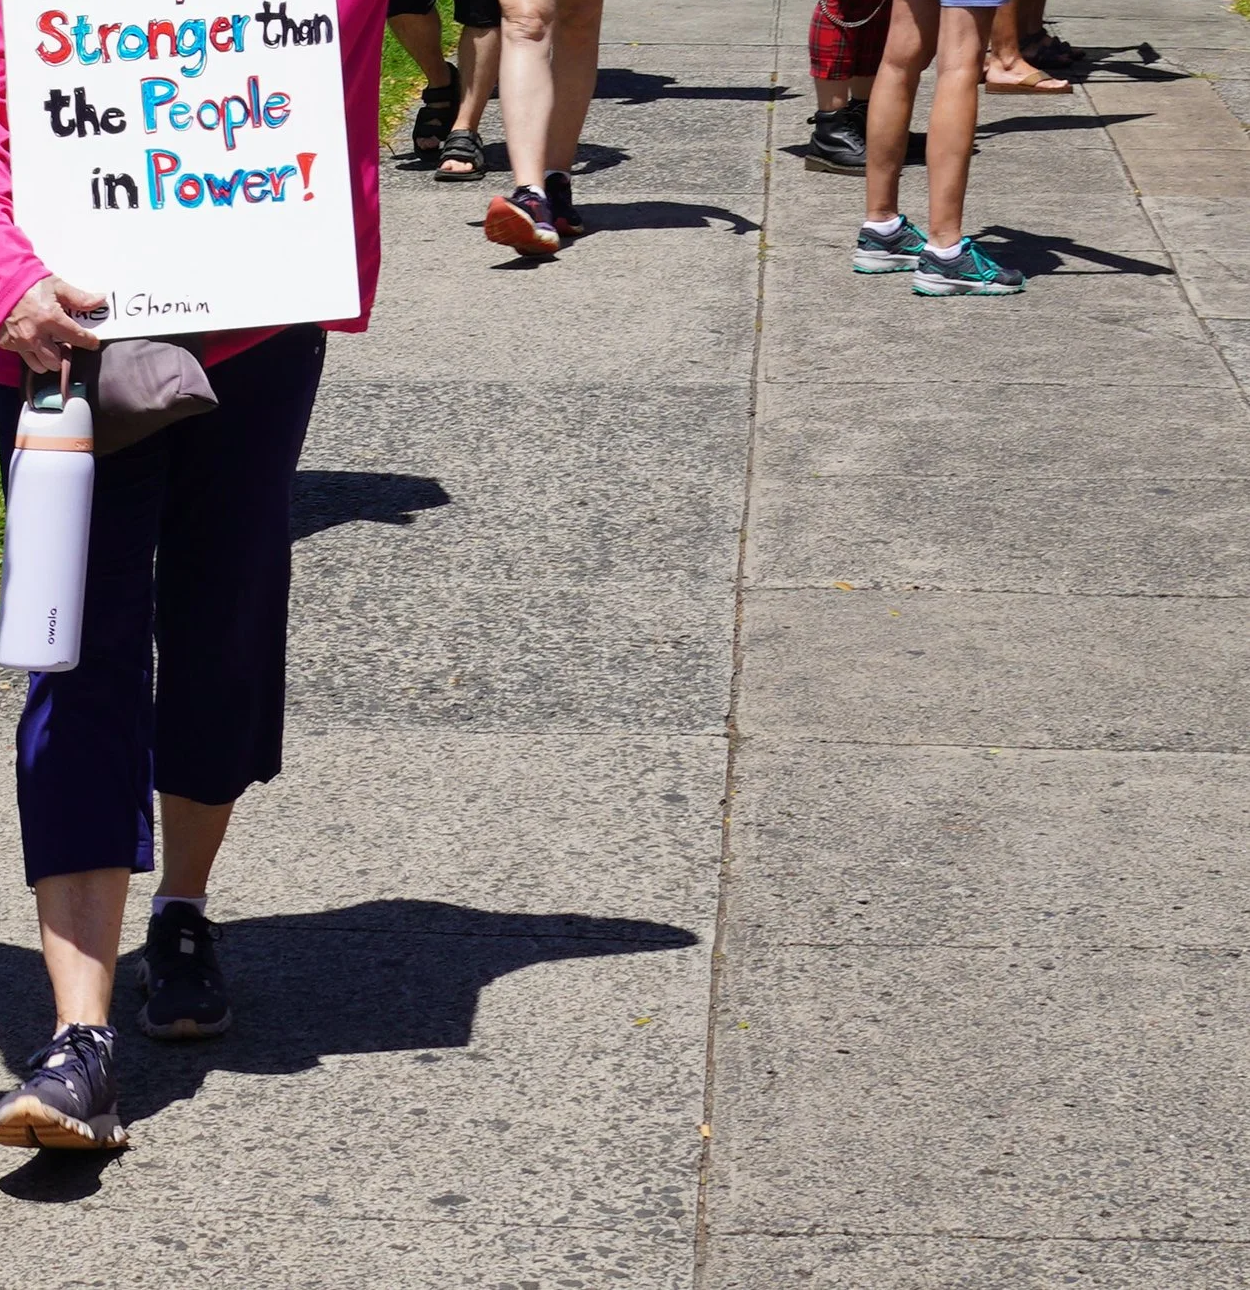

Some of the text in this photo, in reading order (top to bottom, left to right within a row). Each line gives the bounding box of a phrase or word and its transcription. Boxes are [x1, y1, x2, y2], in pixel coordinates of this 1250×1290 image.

[36, 0, 335, 78] Stronger than
[43, 74, 292, 152] the People
[91, 148, 318, 211] in Power!
[47, 607, 58, 645] owala
